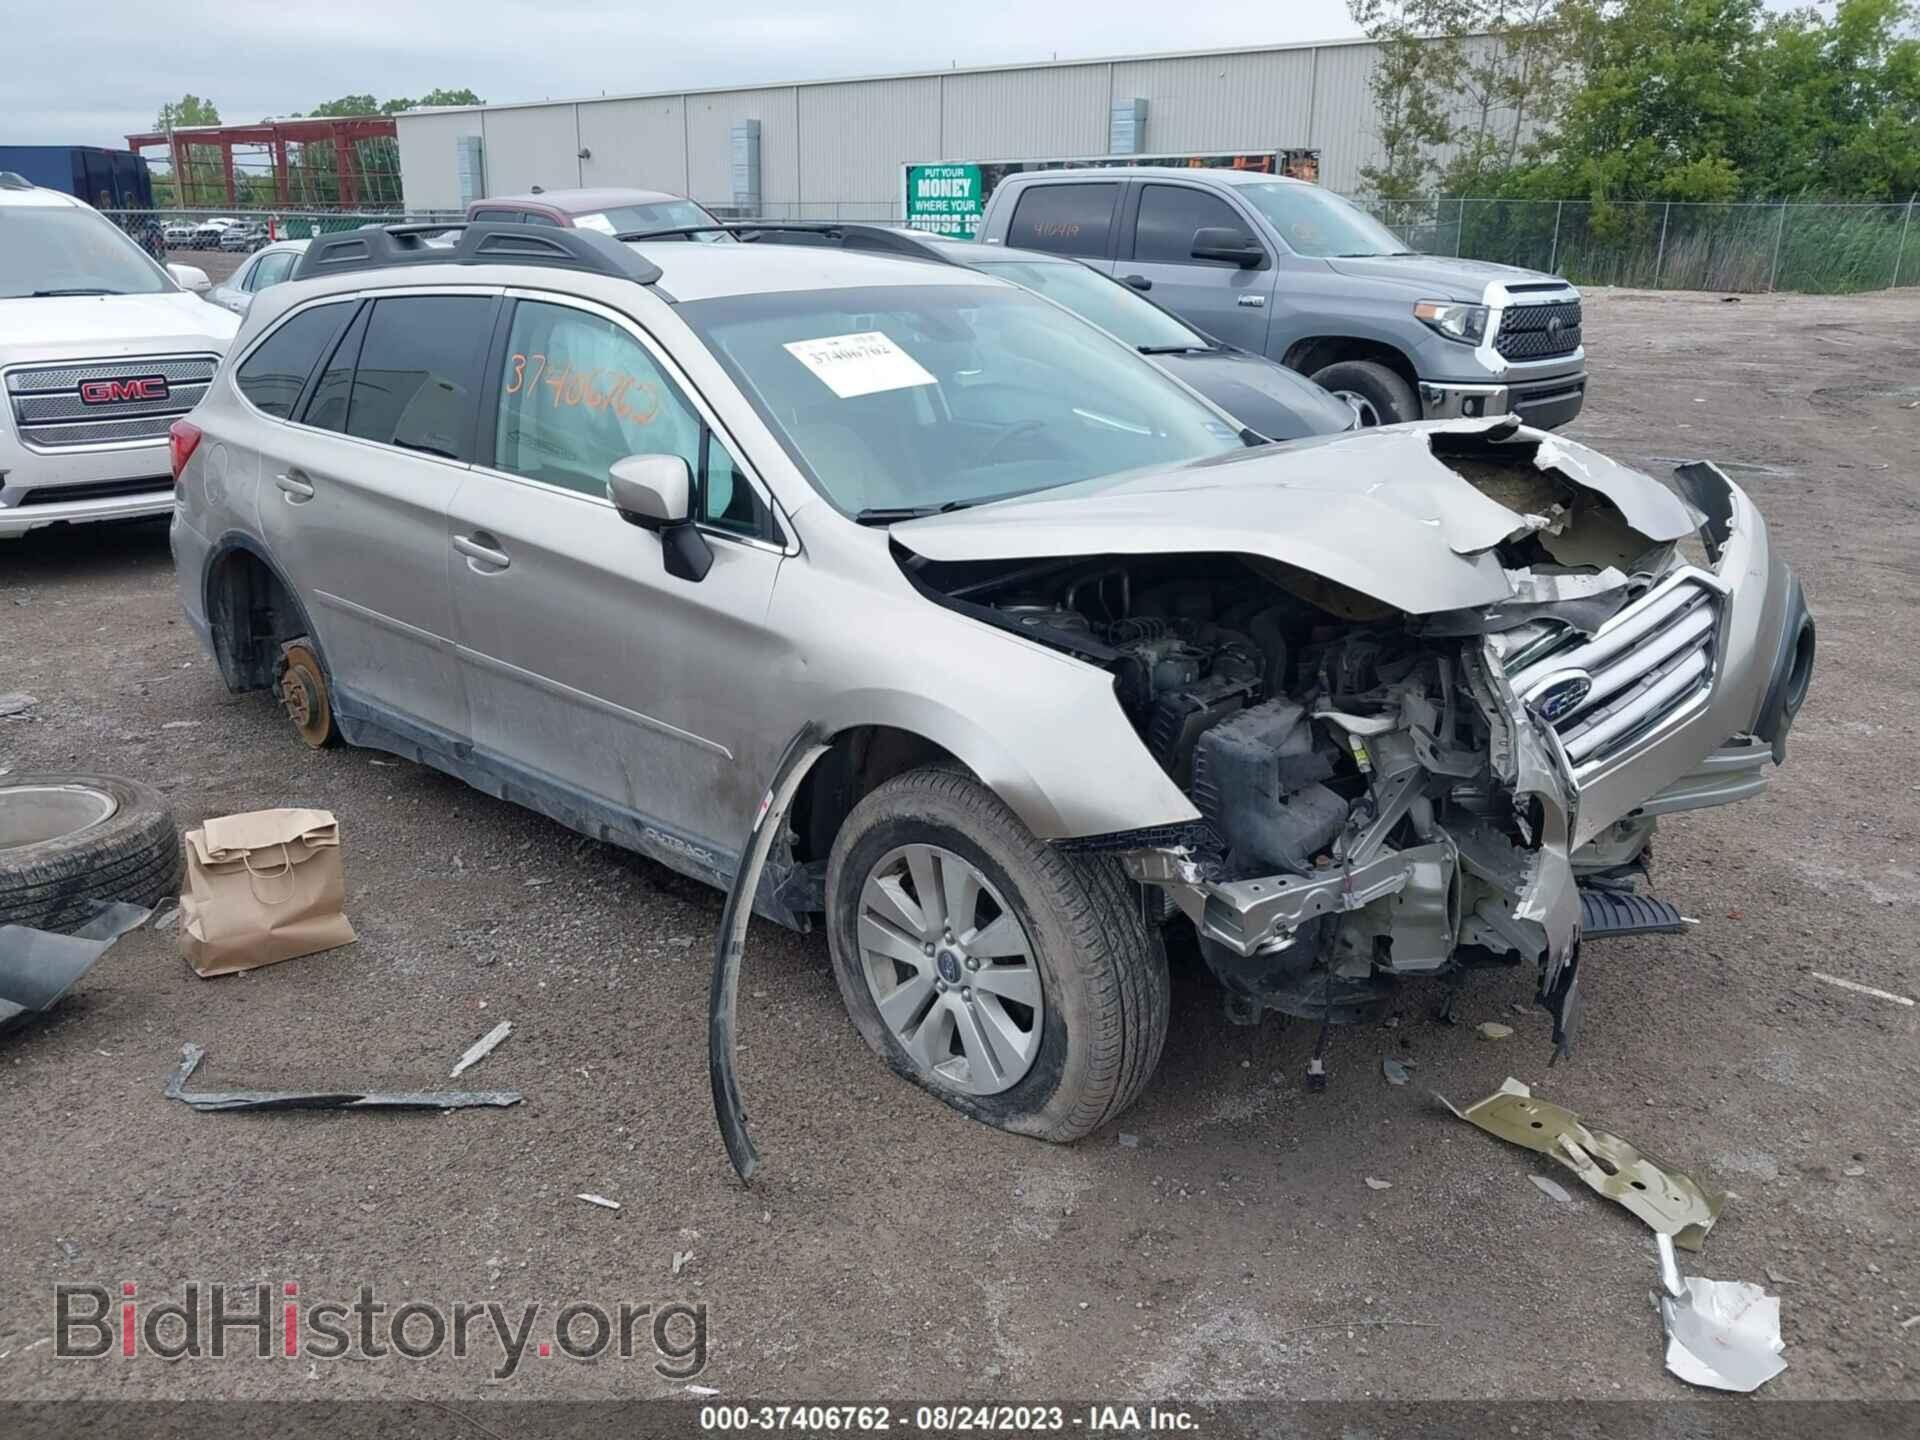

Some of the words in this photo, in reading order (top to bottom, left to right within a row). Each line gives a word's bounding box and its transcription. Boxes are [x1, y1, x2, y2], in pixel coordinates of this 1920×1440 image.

[924, 167, 941, 178] PUT
[941, 167, 965, 177] YOUR
[917, 178, 972, 198] MONEY
[914, 200, 950, 212] WHERE
[950, 199, 976, 211] YOUR
[911, 214, 961, 234] HOUSE
[81, 378, 167, 402] GMC
